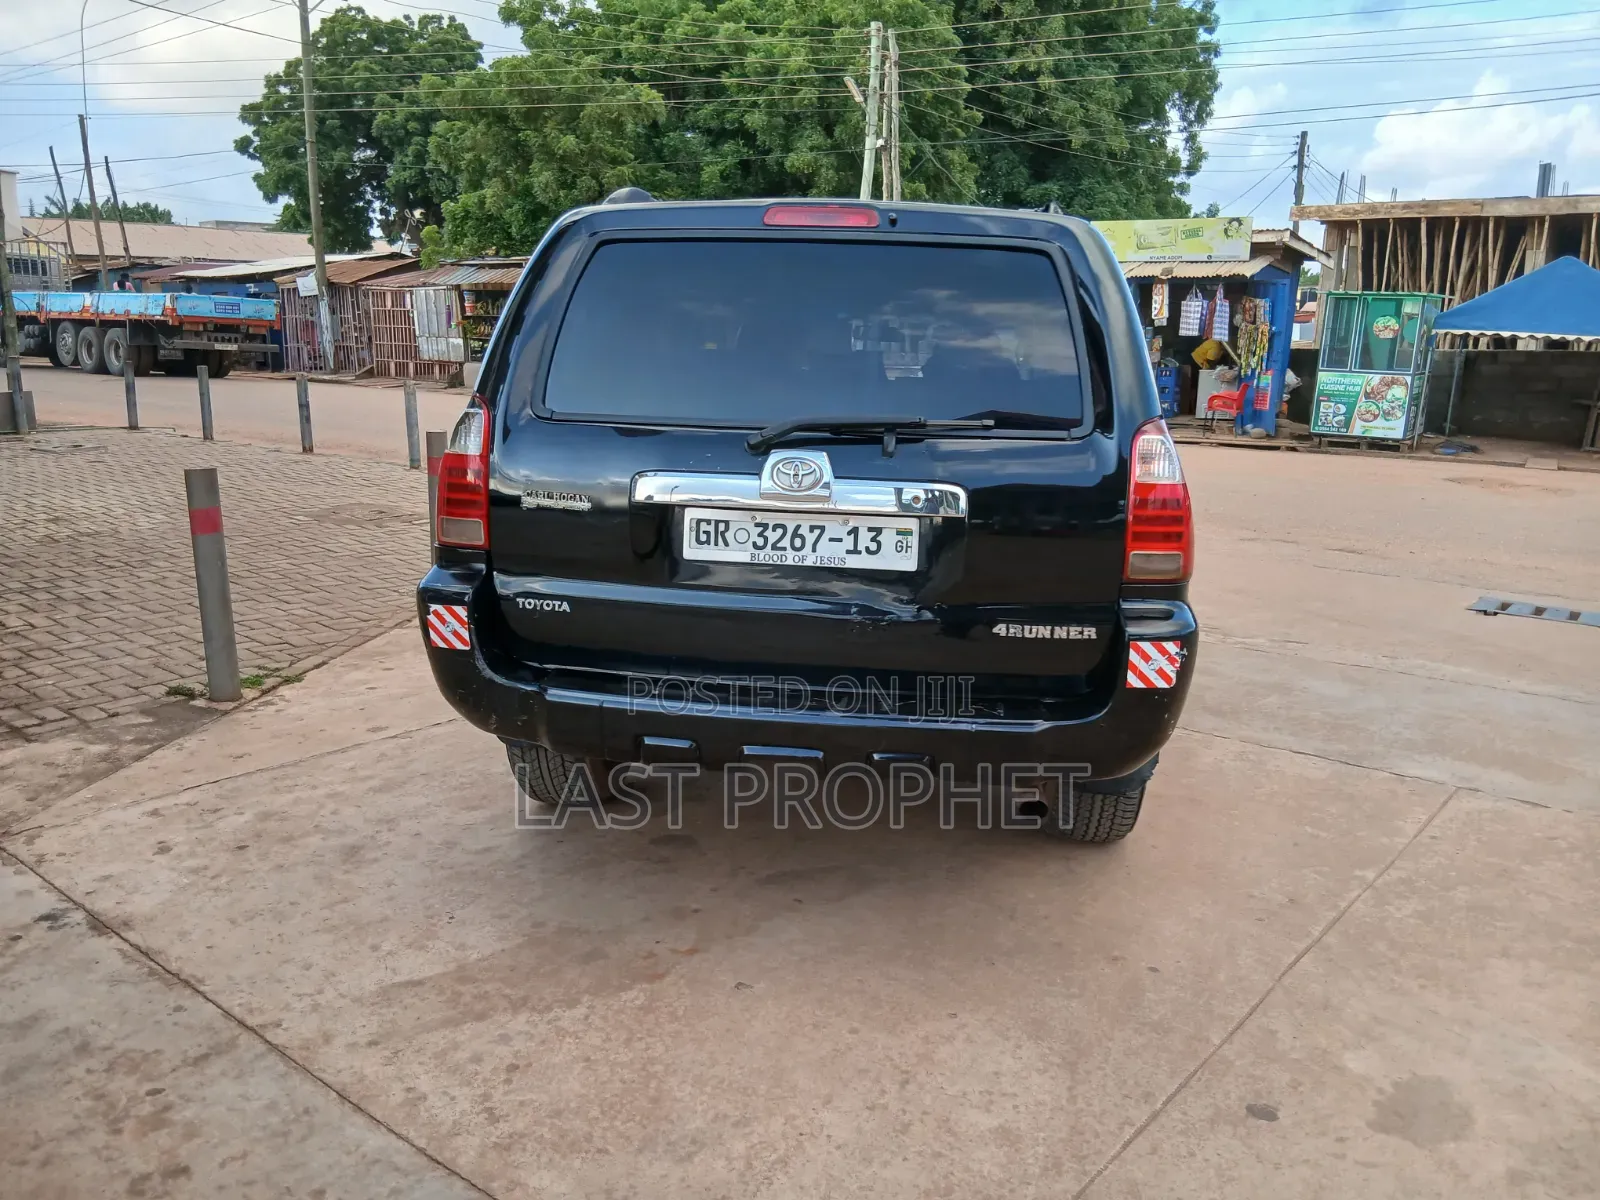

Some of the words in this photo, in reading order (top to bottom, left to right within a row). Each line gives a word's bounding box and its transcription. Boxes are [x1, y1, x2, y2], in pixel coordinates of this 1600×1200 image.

[1319, 383, 1345, 391] CUISINE
[1321, 376, 1362, 385] NORTHERN
[553, 492, 589, 504] HOGAN
[695, 519, 730, 547] GR
[752, 522, 883, 556] 3267-13
[895, 539, 913, 554] GH
[750, 552, 788, 563] BLOOD
[793, 555, 808, 564] OF
[812, 556, 847, 567] JESUS
[516, 598, 571, 613] TOYOTA
[992, 623, 1098, 640] 4RUNNER
